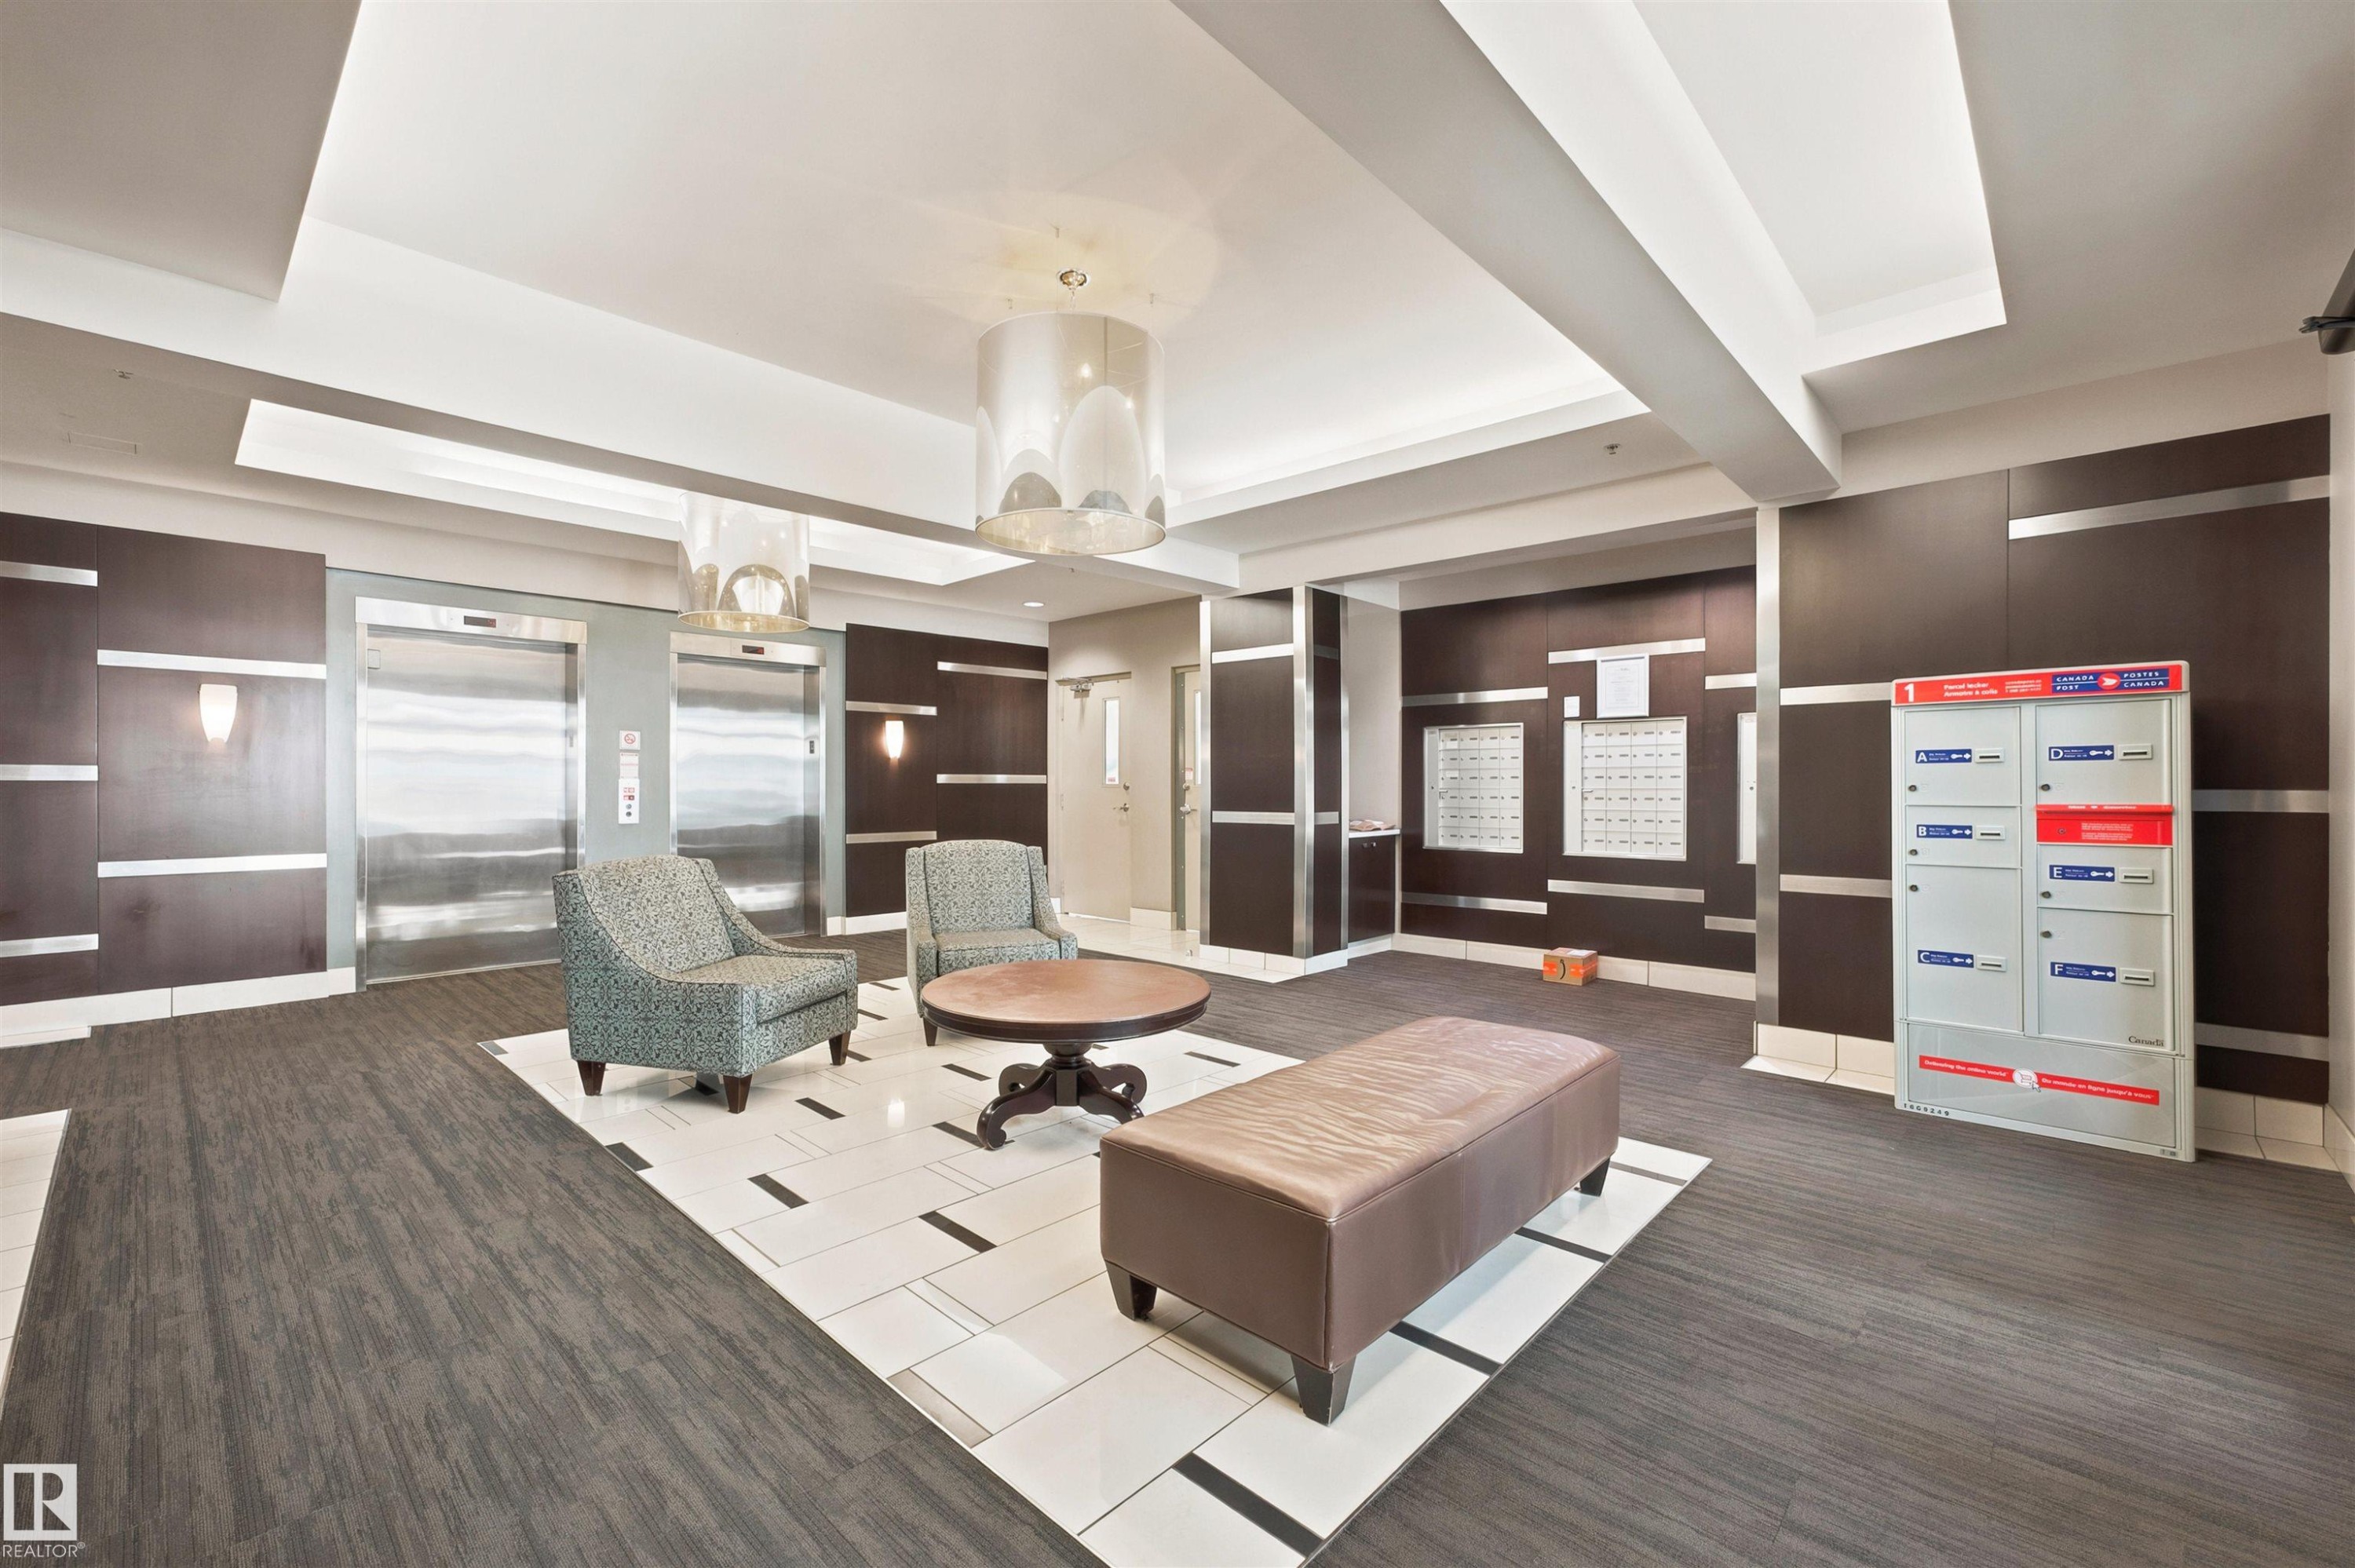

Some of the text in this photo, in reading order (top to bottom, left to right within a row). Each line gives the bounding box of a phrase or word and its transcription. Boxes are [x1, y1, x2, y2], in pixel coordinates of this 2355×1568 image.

[1904, 683, 1915, 703] 1
[1917, 752, 1927, 763] A
[2050, 748, 2064, 760] D
[1918, 826, 1927, 837] B
[2053, 866, 2063, 878] E
[1919, 952, 1930, 963] C
[2054, 964, 2064, 975] F
